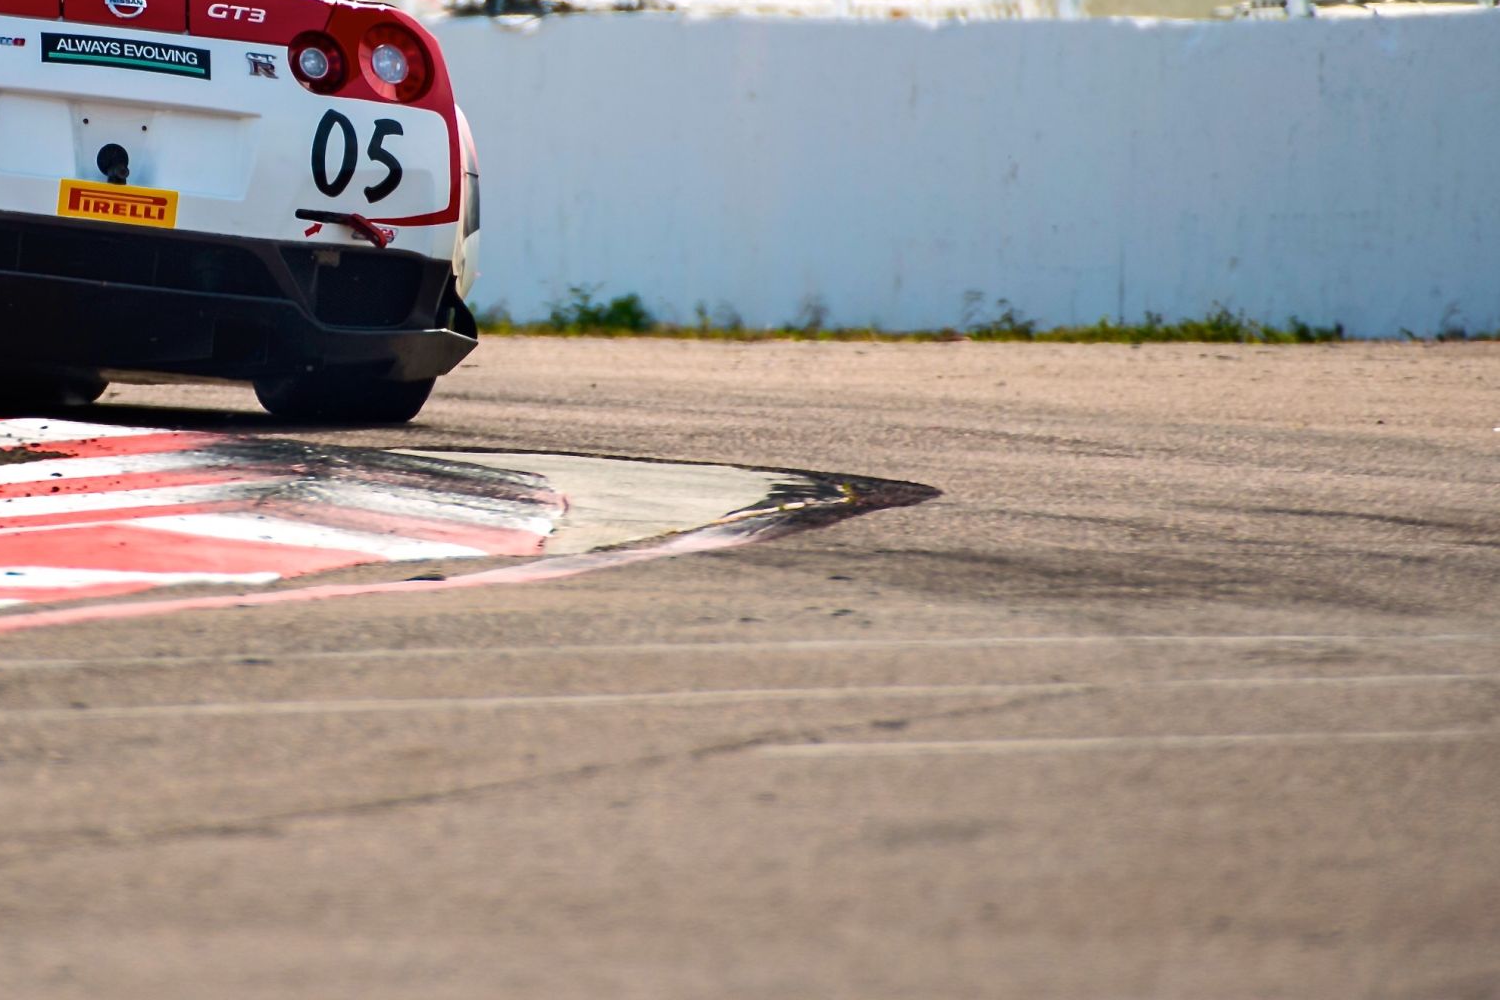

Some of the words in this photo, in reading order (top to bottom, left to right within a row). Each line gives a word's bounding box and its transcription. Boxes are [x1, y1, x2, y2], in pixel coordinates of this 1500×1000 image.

[207, 3, 266, 23] GT3
[56, 37, 121, 55] ALWAYS
[124, 44, 198, 65] EVOLVING
[311, 108, 404, 204] 05
[68, 187, 168, 220] PIRELLI
